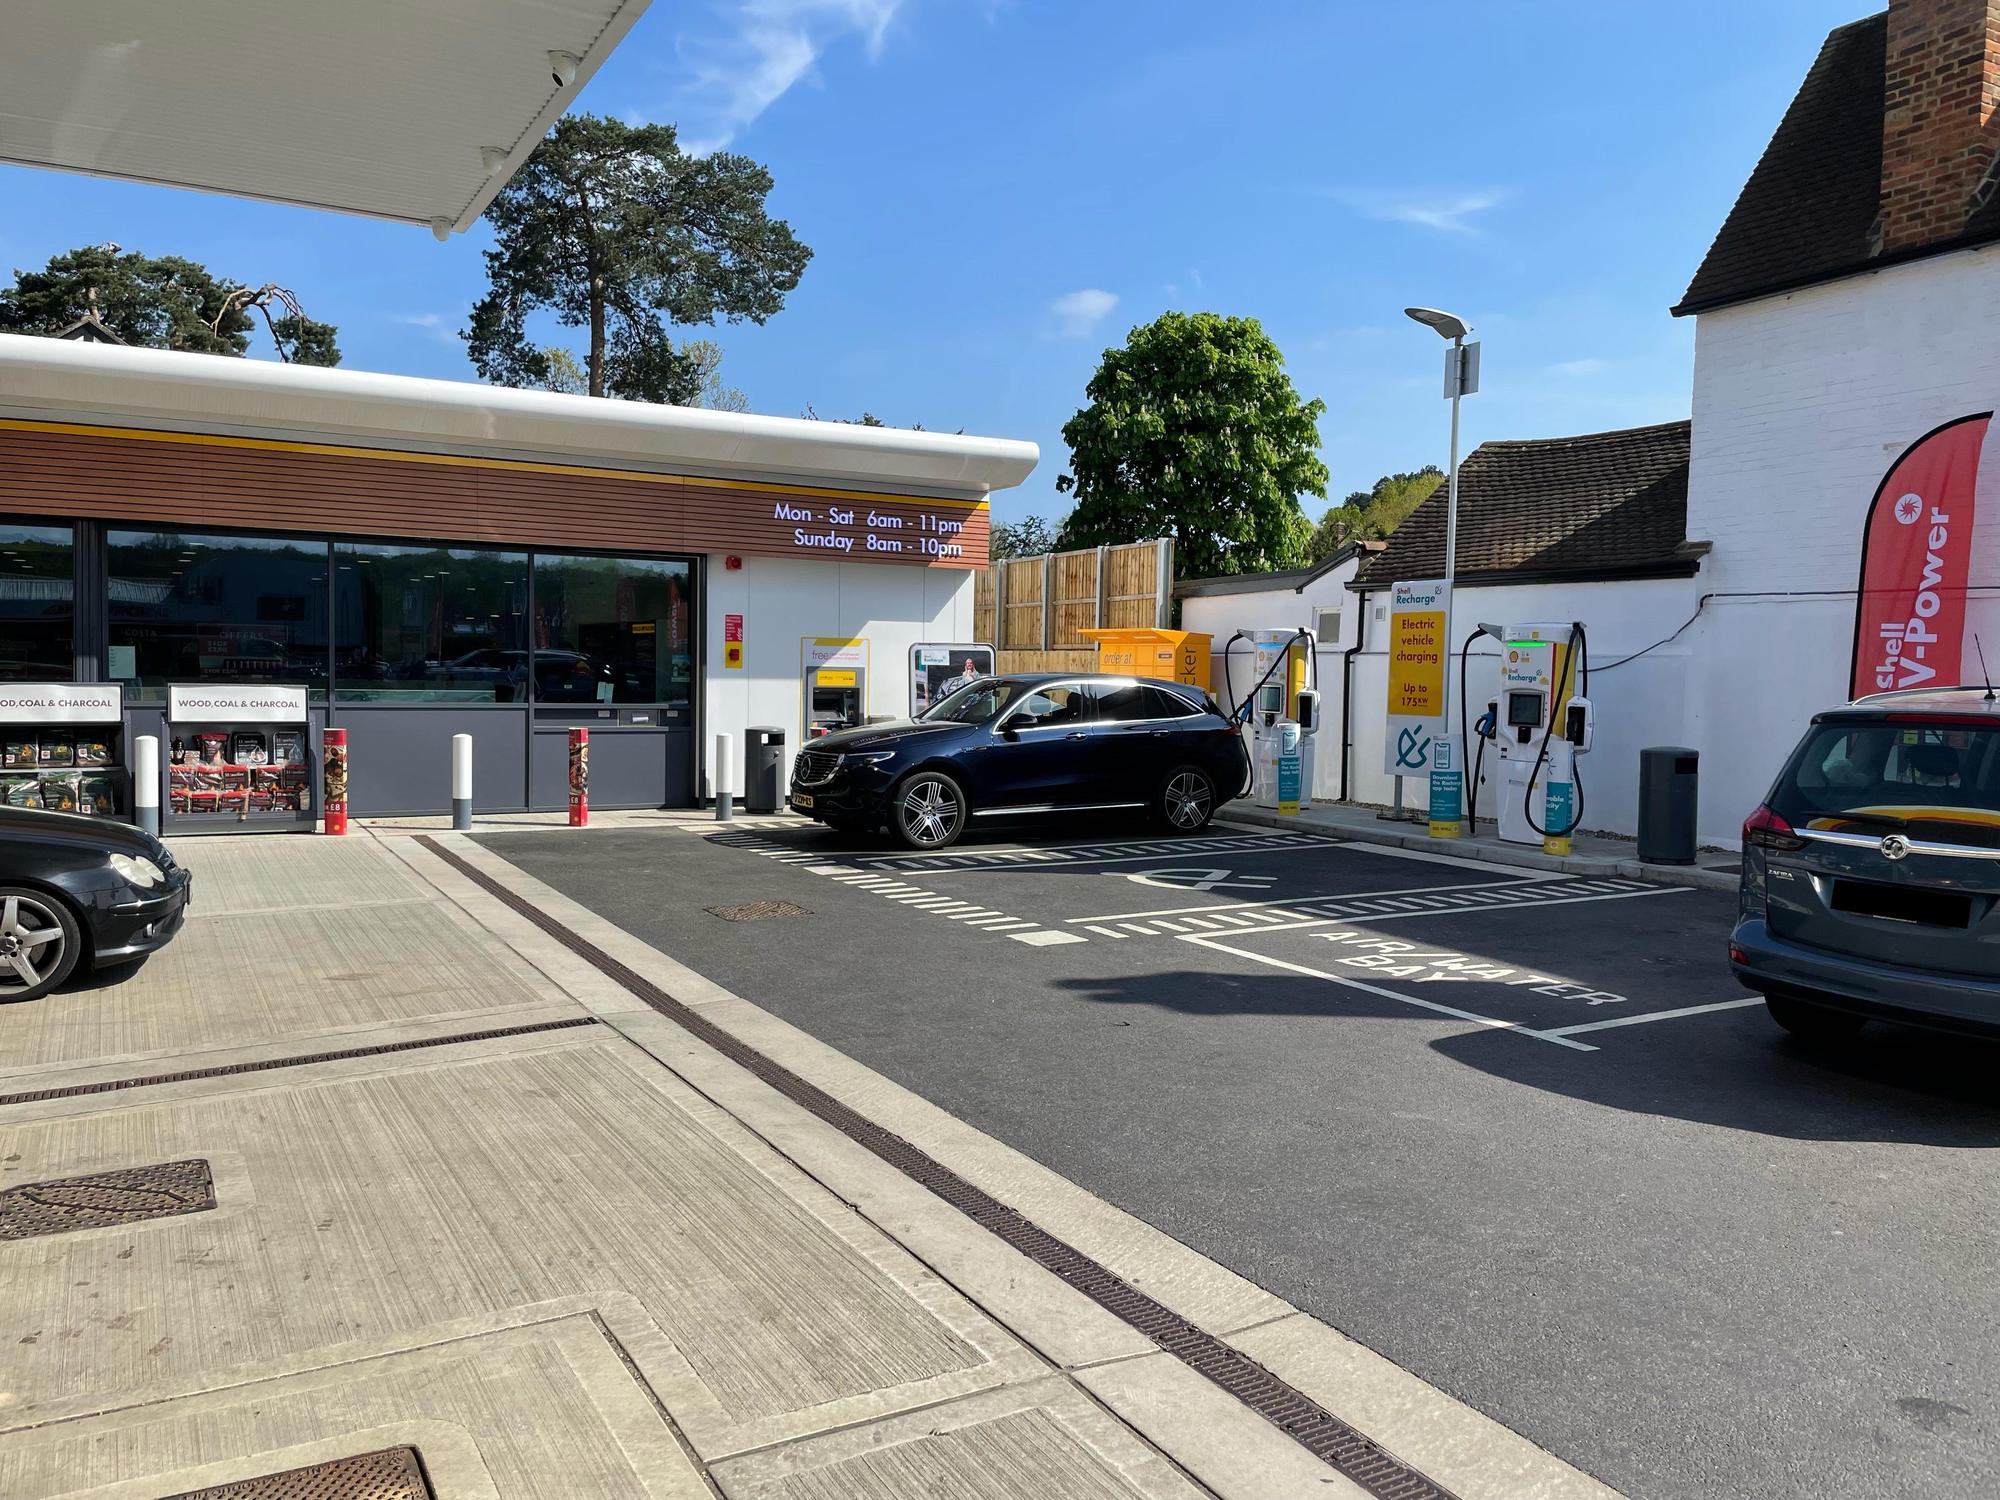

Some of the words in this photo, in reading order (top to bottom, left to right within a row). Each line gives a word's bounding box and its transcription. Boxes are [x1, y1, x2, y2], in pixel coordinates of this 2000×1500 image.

[774, 502, 812, 521] Mon
[829, 507, 854, 525] Sat
[866, 510, 902, 529] 6am
[920, 514, 962, 535] 11pm
[794, 529, 854, 552] Sunday
[866, 534, 902, 552] 8am
[920, 538, 962, 558] 10pm
[1397, 587, 1411, 595] Shell
[1898, 506, 1951, 688] V-Power
[1396, 594, 1436, 606] Recharge
[1402, 618, 1435, 630] Electric
[1401, 634, 1434, 646] vehicle
[1396, 651, 1438, 664] charging
[1180, 646, 1197, 686] cker
[1507, 674, 1537, 683] Recharge
[1403, 683, 1416, 695] Up
[1418, 684, 1428, 693] to
[0, 699, 46, 708] OD,COAL
[47, 699, 56, 707] &
[58, 699, 113, 708] CHARCOAL
[240, 700, 248, 708] &
[249, 700, 300, 709] CHARCOAL
[1768, 869, 1793, 878] ZAFIRA
[1309, 931, 1628, 1006] AIR/WATER
[1335, 954, 1469, 983] BAY
